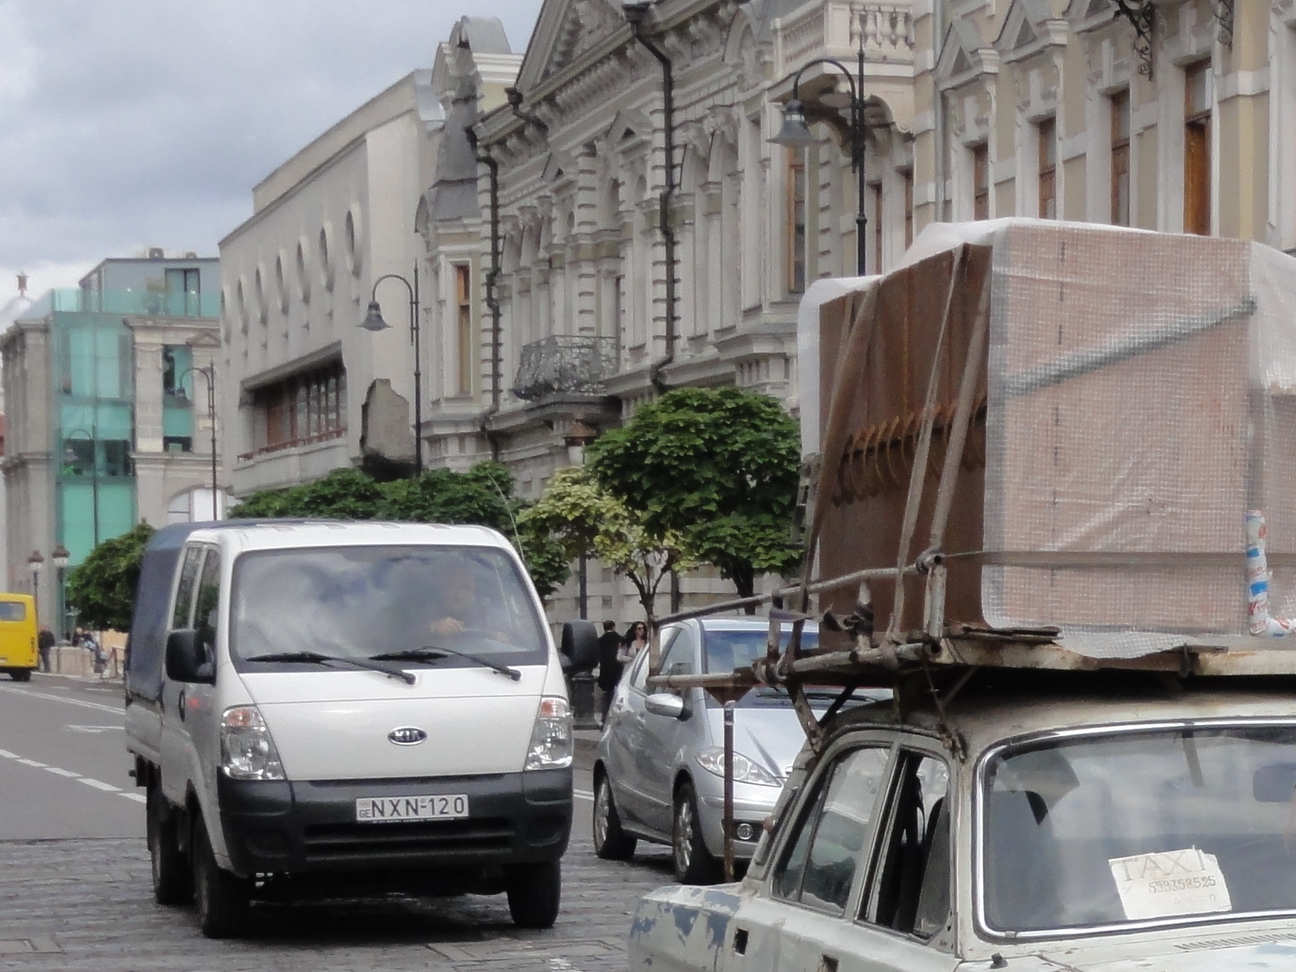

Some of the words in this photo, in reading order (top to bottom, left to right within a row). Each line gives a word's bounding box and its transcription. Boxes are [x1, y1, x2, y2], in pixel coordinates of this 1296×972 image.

[371, 796, 466, 818] NXN-120
[1120, 848, 1207, 882] TAXI
[1148, 875, 1217, 894] 599358525
